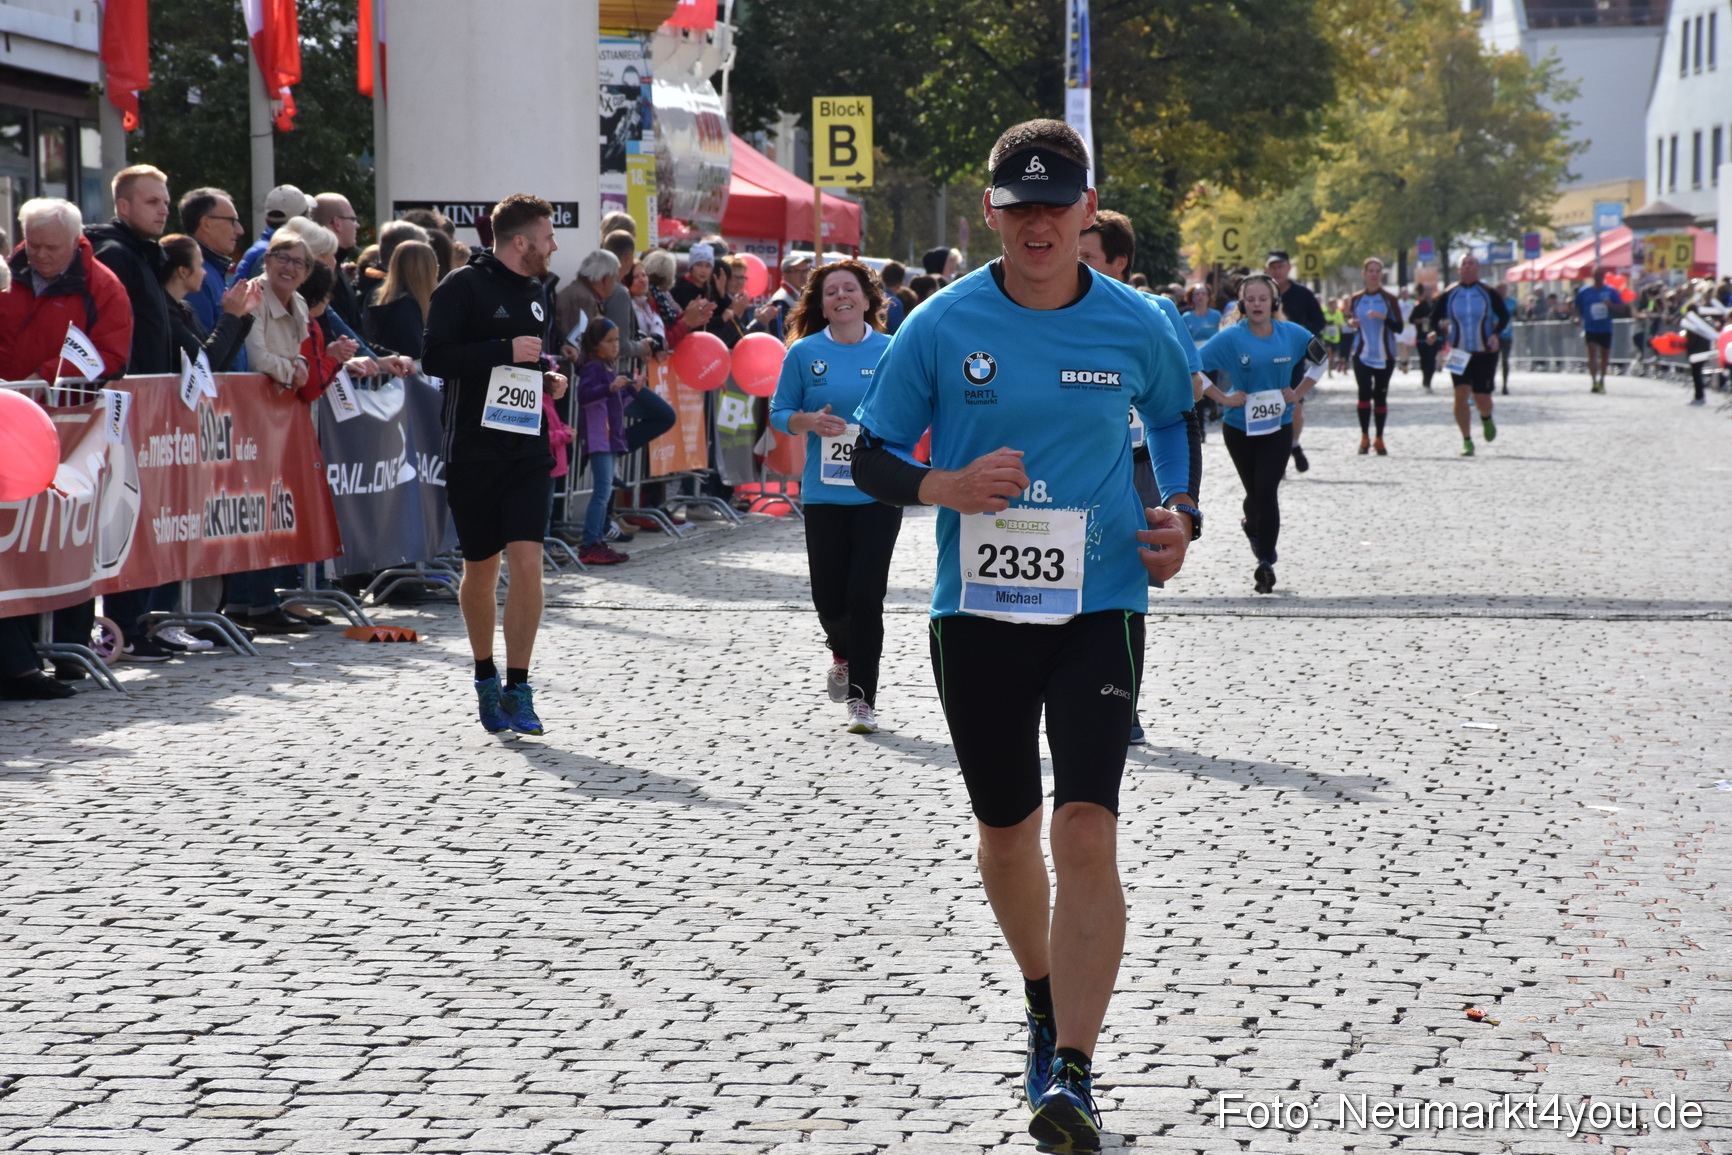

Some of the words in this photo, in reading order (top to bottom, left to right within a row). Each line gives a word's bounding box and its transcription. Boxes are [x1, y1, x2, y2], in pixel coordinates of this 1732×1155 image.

[820, 101, 865, 117] Block
[829, 125, 858, 167] B
[1223, 228, 1239, 251] C
[1676, 245, 1689, 262] D
[1305, 254, 1318, 270] D
[966, 352, 994, 365] BMW
[1060, 370, 1121, 385] BOCK
[497, 385, 536, 409] 2909
[964, 389, 998, 399] PARTL
[965, 398, 998, 406] Neumarkt
[113, 391, 122, 424] swn
[1252, 403, 1281, 419] 2945
[327, 457, 398, 496] RAIL.ONE
[1023, 480, 1053, 503] 18.
[1007, 519, 1050, 531] BOCK
[977, 543, 1065, 582] 2333
[995, 590, 1042, 605] Michael
[1112, 687, 1131, 700] asics
